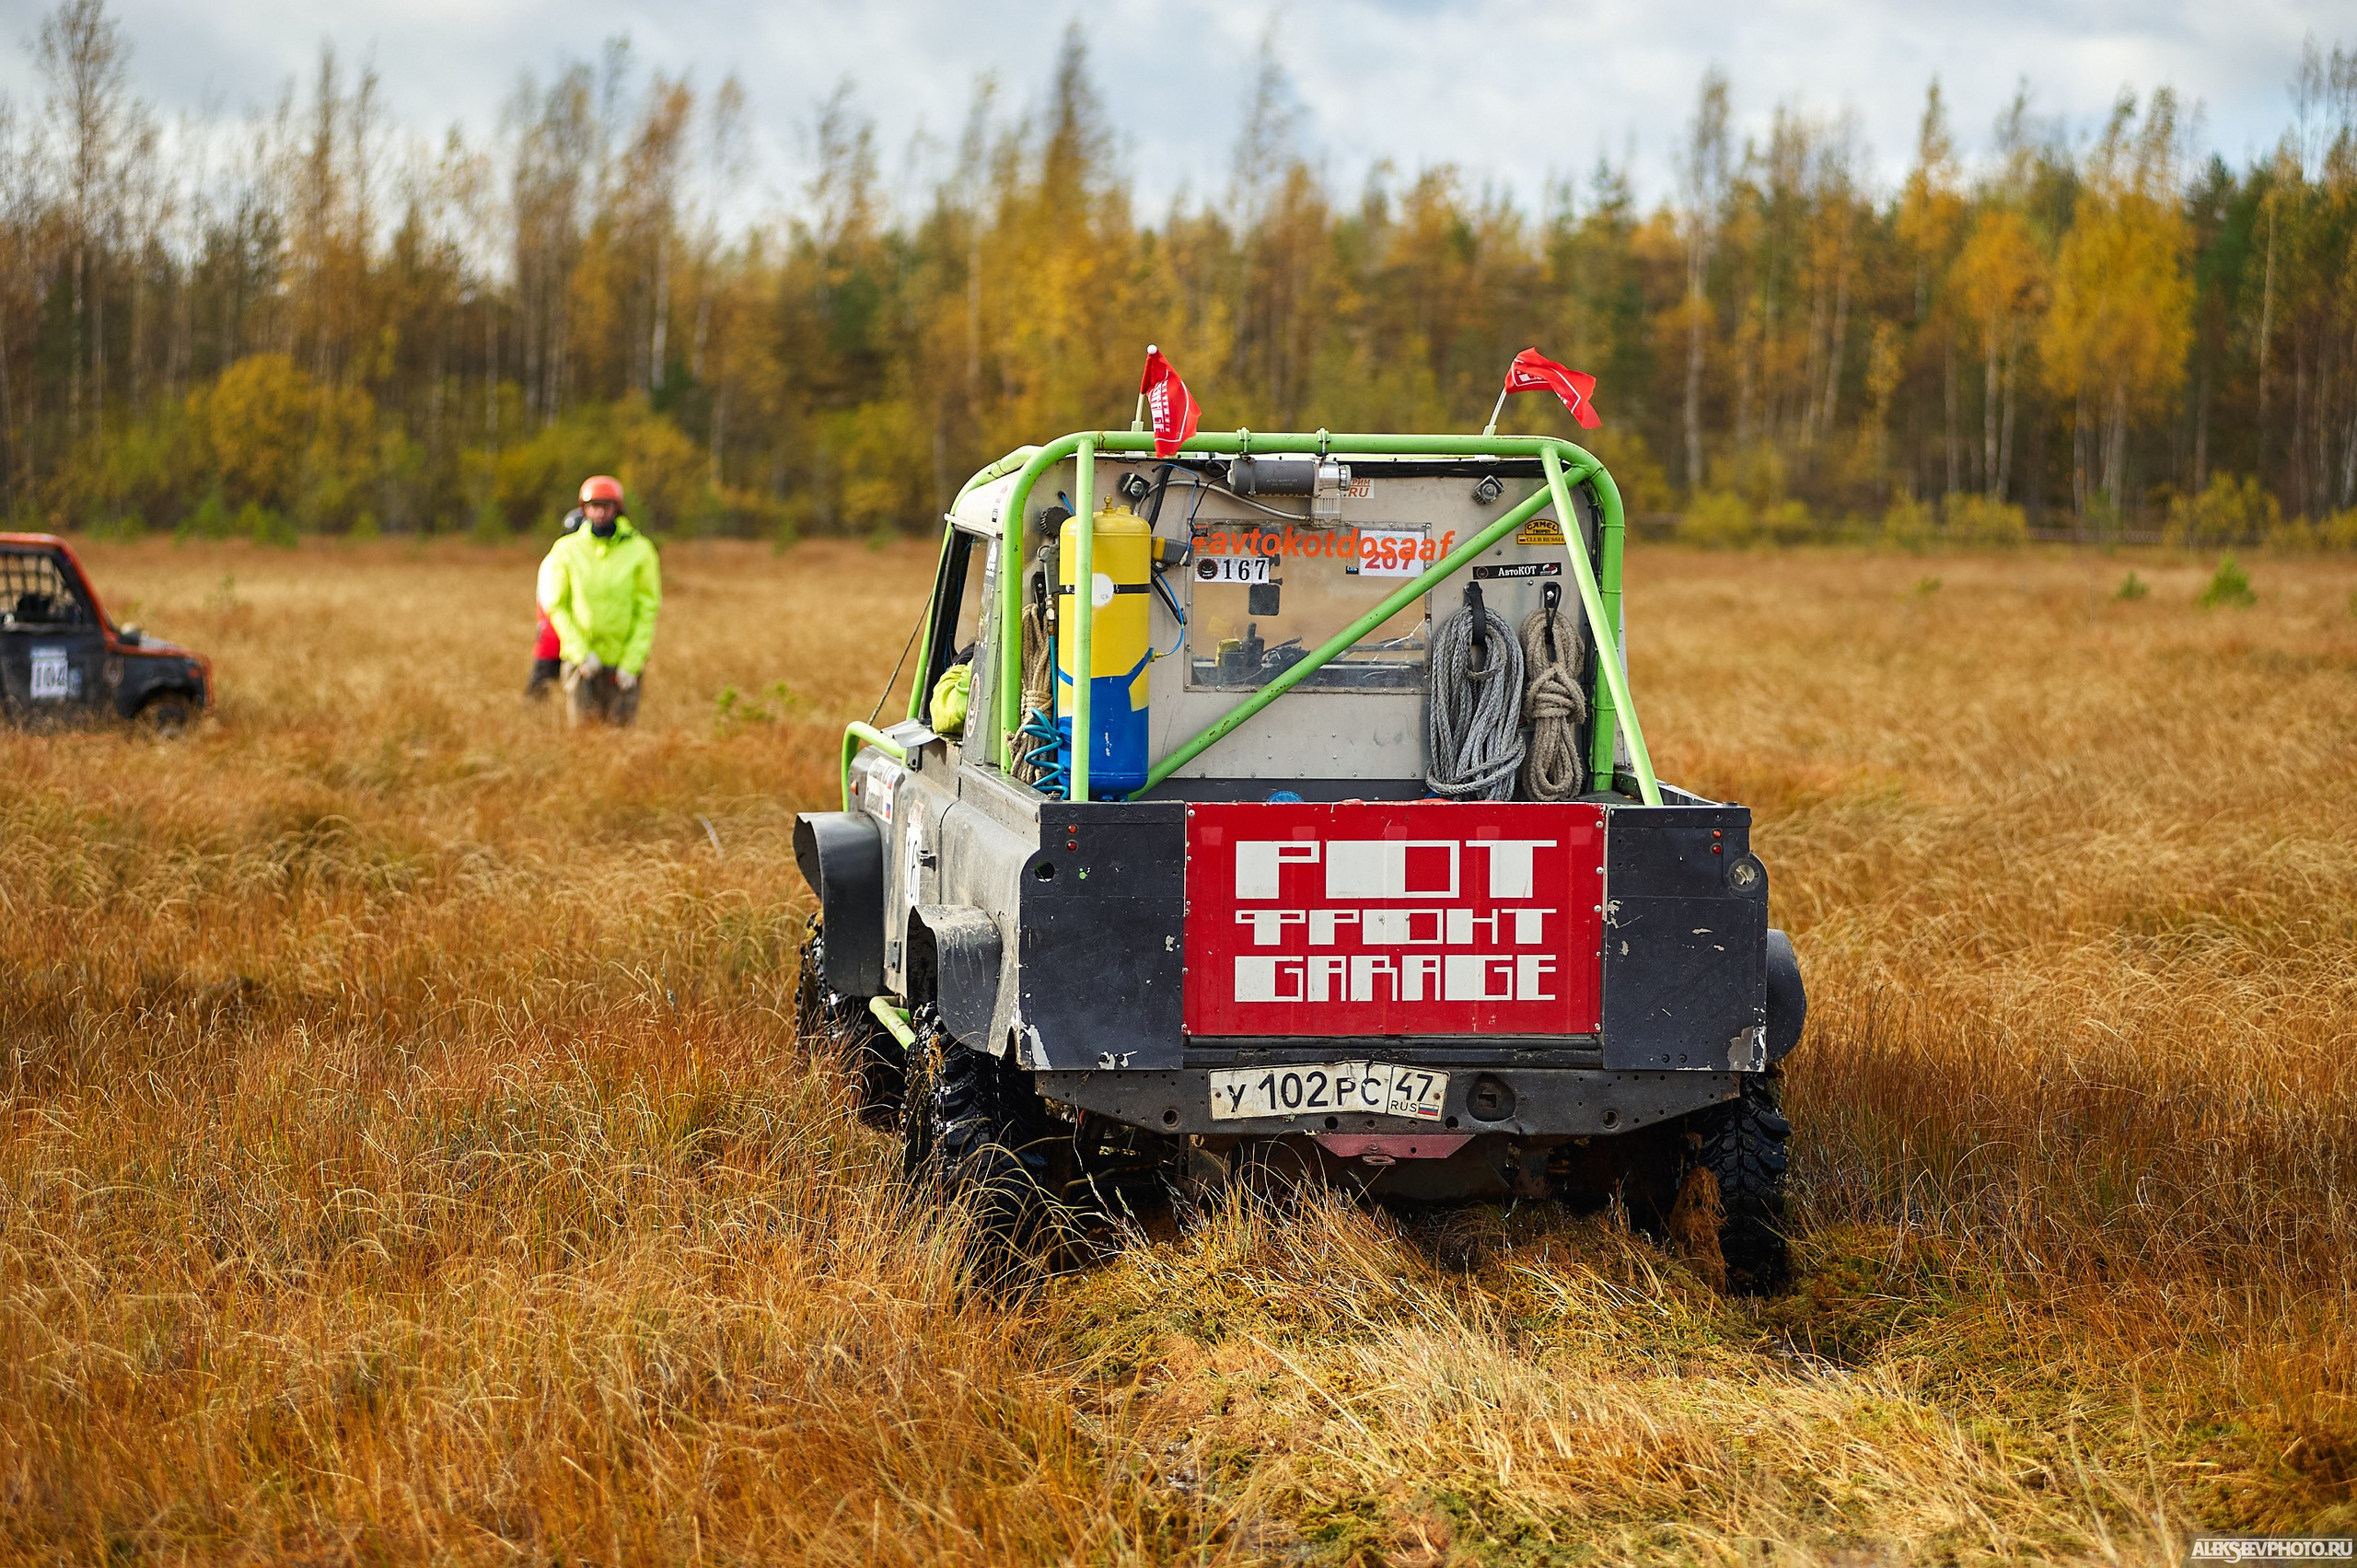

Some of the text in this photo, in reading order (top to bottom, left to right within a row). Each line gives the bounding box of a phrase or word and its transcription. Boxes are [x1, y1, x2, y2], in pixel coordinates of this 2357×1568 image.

[1527, 521, 1557, 530] CAMEL
[1223, 558, 1266, 581] 167
[1235, 954, 1557, 1002] GARAGE
[1396, 1073, 1434, 1102] 47
[1390, 1100, 1417, 1113] RUS
